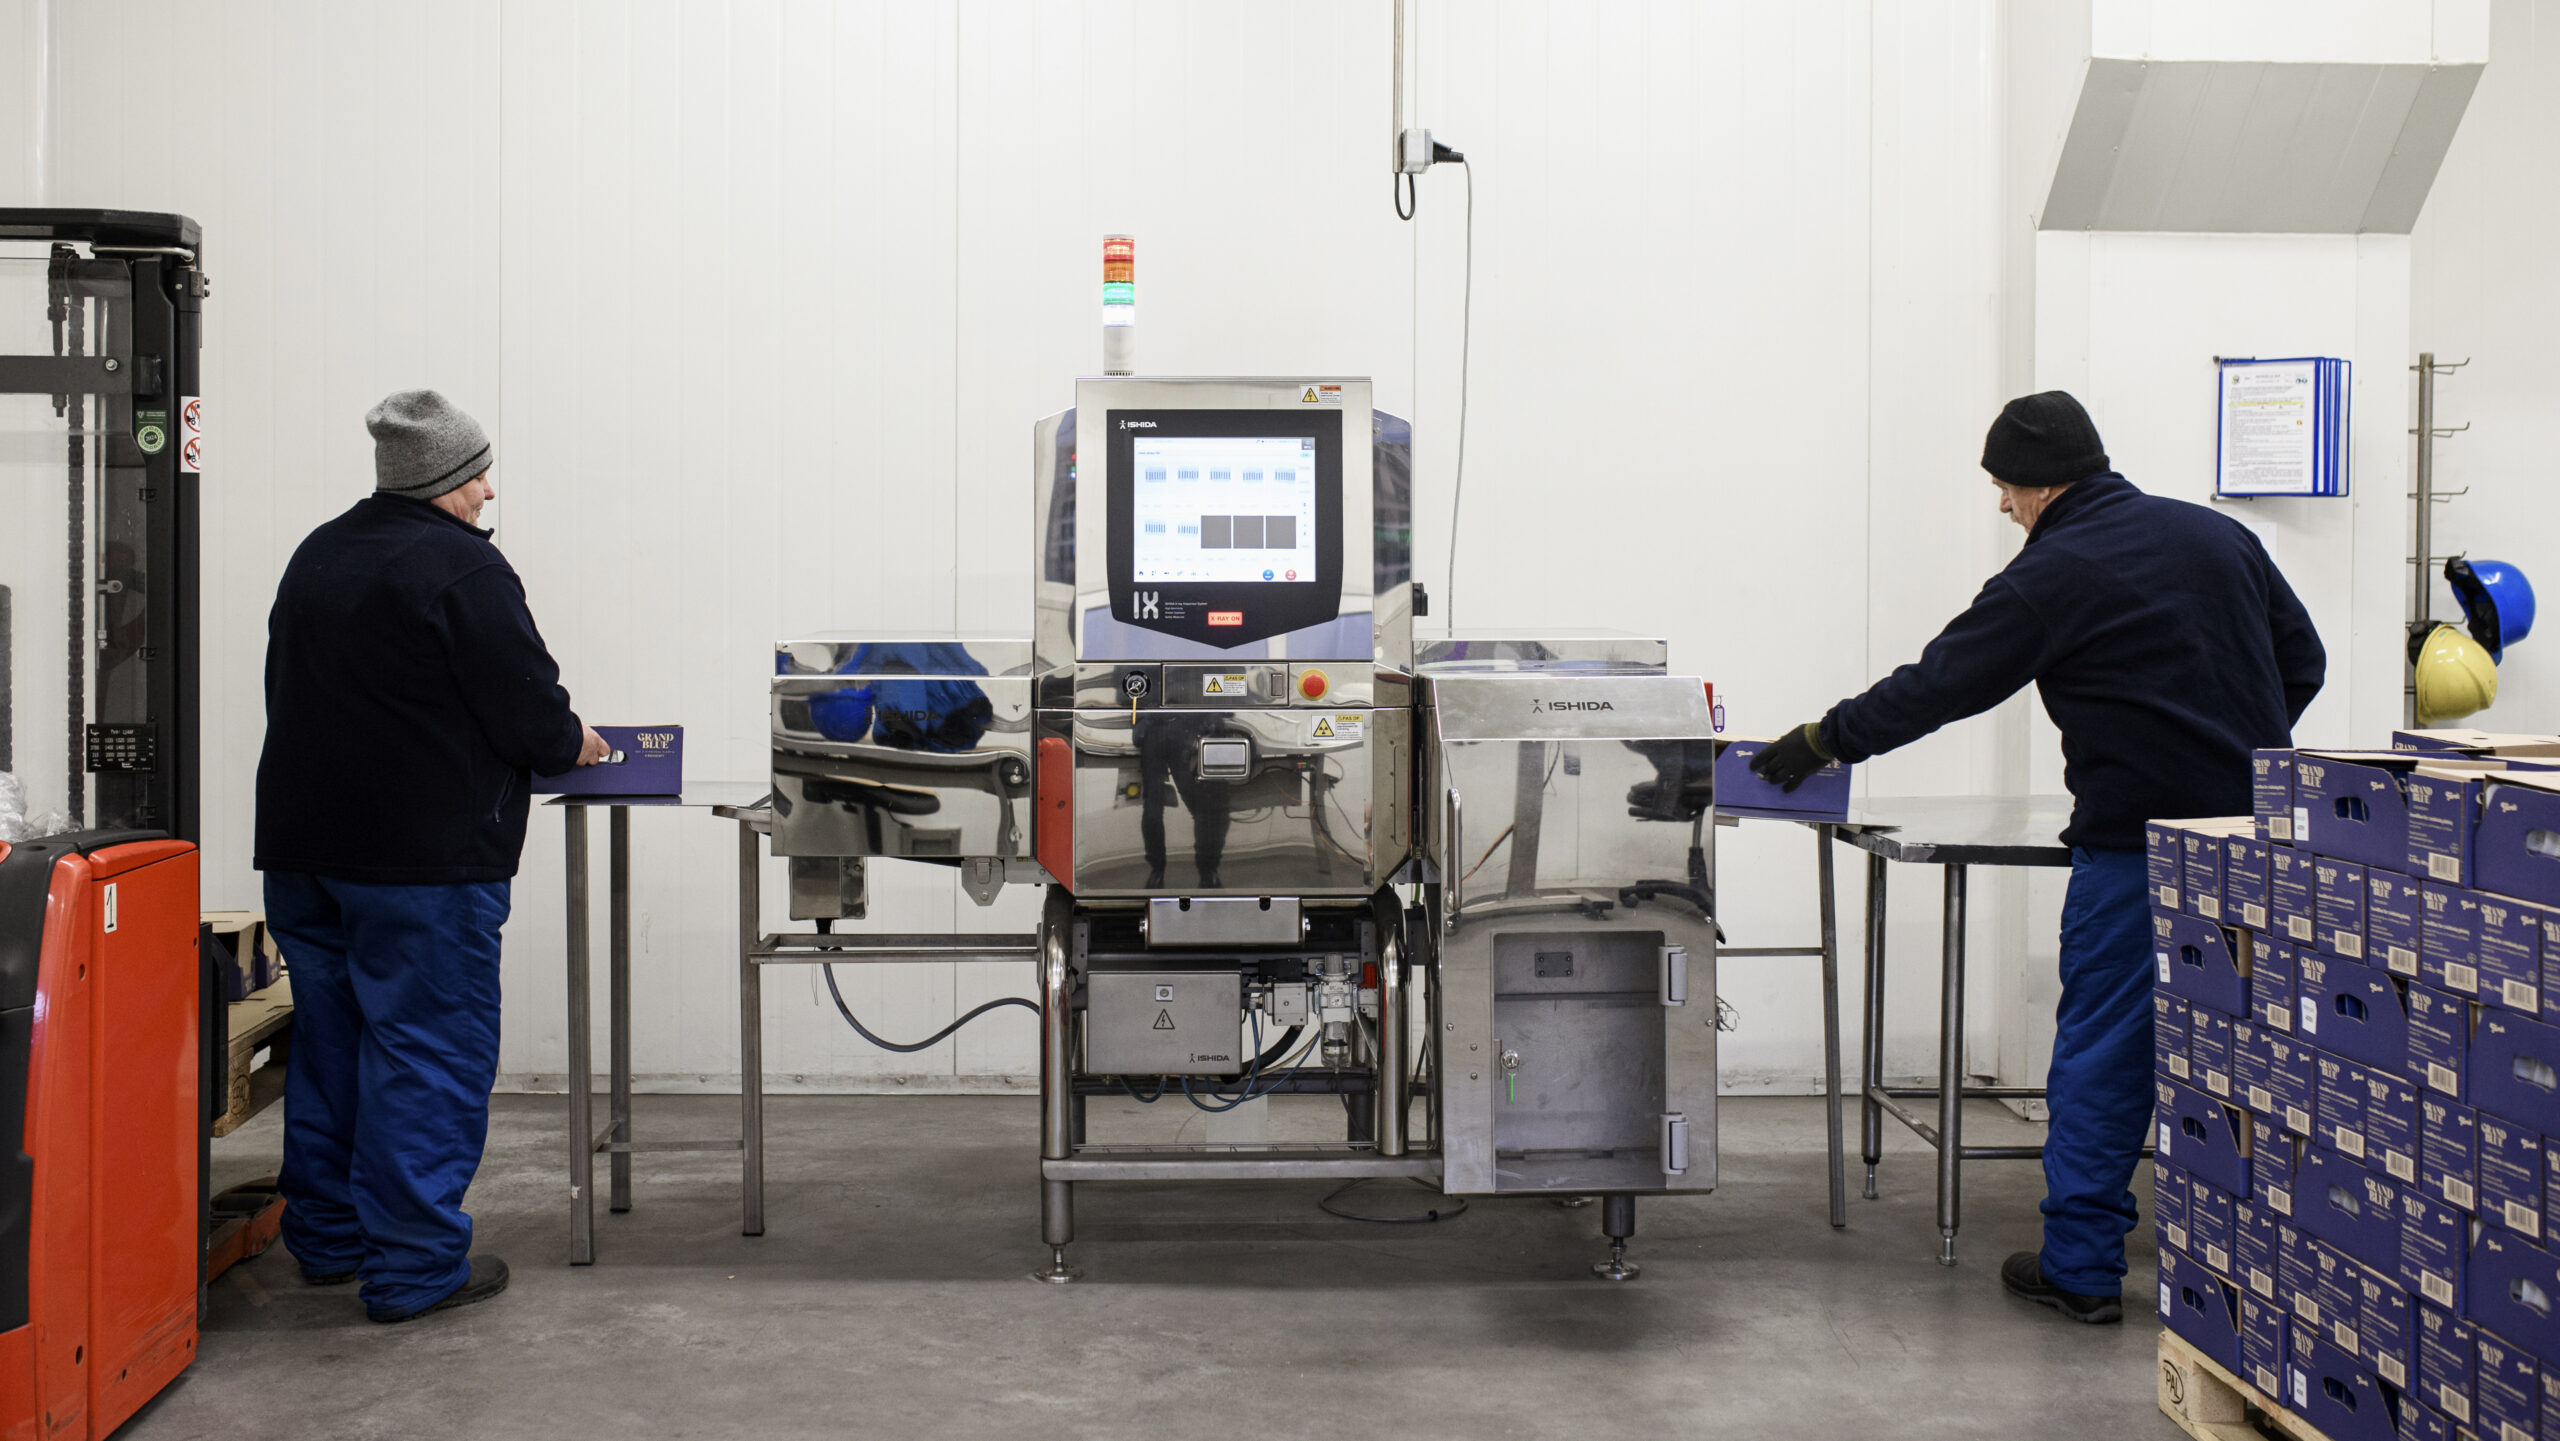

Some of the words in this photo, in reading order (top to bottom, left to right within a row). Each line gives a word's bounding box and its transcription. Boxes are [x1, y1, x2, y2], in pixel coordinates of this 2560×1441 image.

[1134, 591, 1159, 620] IX
[1549, 702, 1614, 711] ISHIDA
[637, 732, 674, 742] GRAND
[642, 740, 668, 749] BLUE
[2298, 763, 2325, 778] GRAND
[106, 886, 114, 929] 1
[2301, 956, 2326, 974] GRAND
[2364, 1177, 2394, 1200] GRAND
